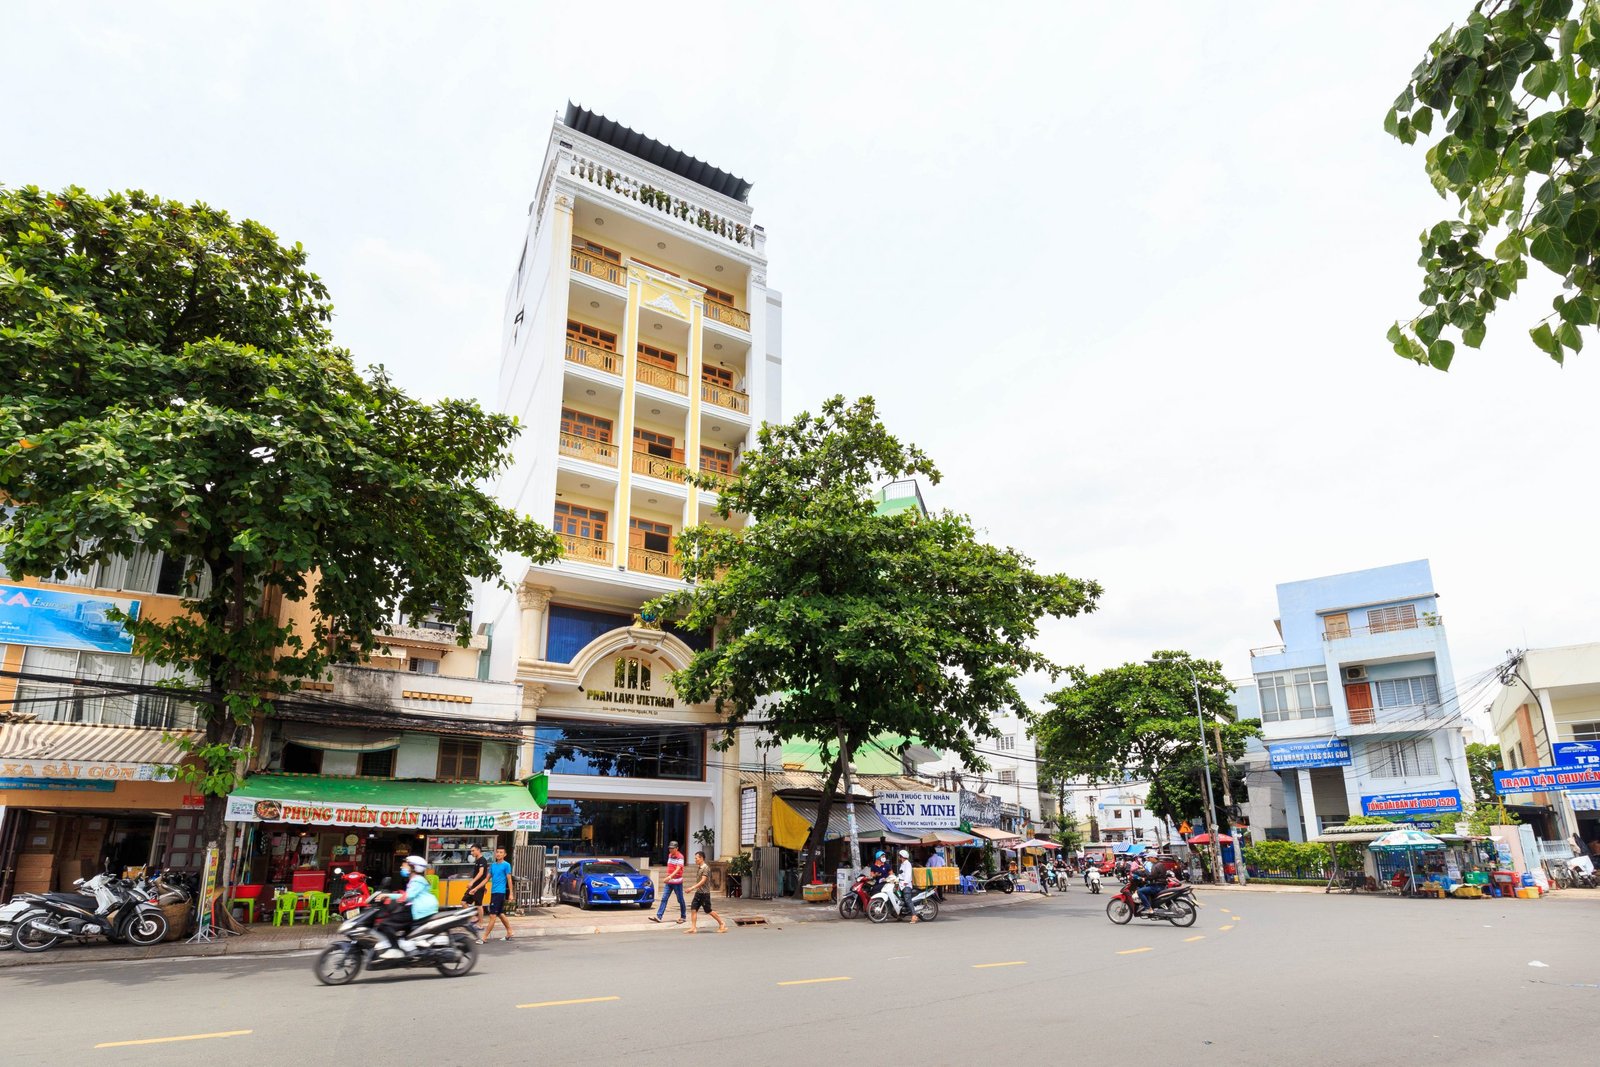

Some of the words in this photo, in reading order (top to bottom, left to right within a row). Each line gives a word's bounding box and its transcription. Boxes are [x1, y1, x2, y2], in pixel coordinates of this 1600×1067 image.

[587, 689, 612, 702] PHAN
[614, 692, 634, 705] LAW
[636, 694, 675, 708] VIETNAM
[42, 762, 83, 777] SÀI
[88, 764, 136, 779] GÒN
[1500, 777, 1530, 789] TRẠM
[1532, 774, 1555, 787] VẬN
[900, 792, 922, 800] THUỐC
[1419, 799, 1437, 808] 1900
[1438, 797, 1456, 807] 1520
[519, 811, 539, 820] 228
[880, 800, 915, 816] HIỀN
[920, 804, 956, 816] MINH
[282, 805, 334, 823] PHỤNG
[335, 805, 379, 823] THIÊN
[380, 807, 420, 826] QUÁN
[421, 811, 439, 827] PHÁ
[441, 809, 458, 828] LẤU
